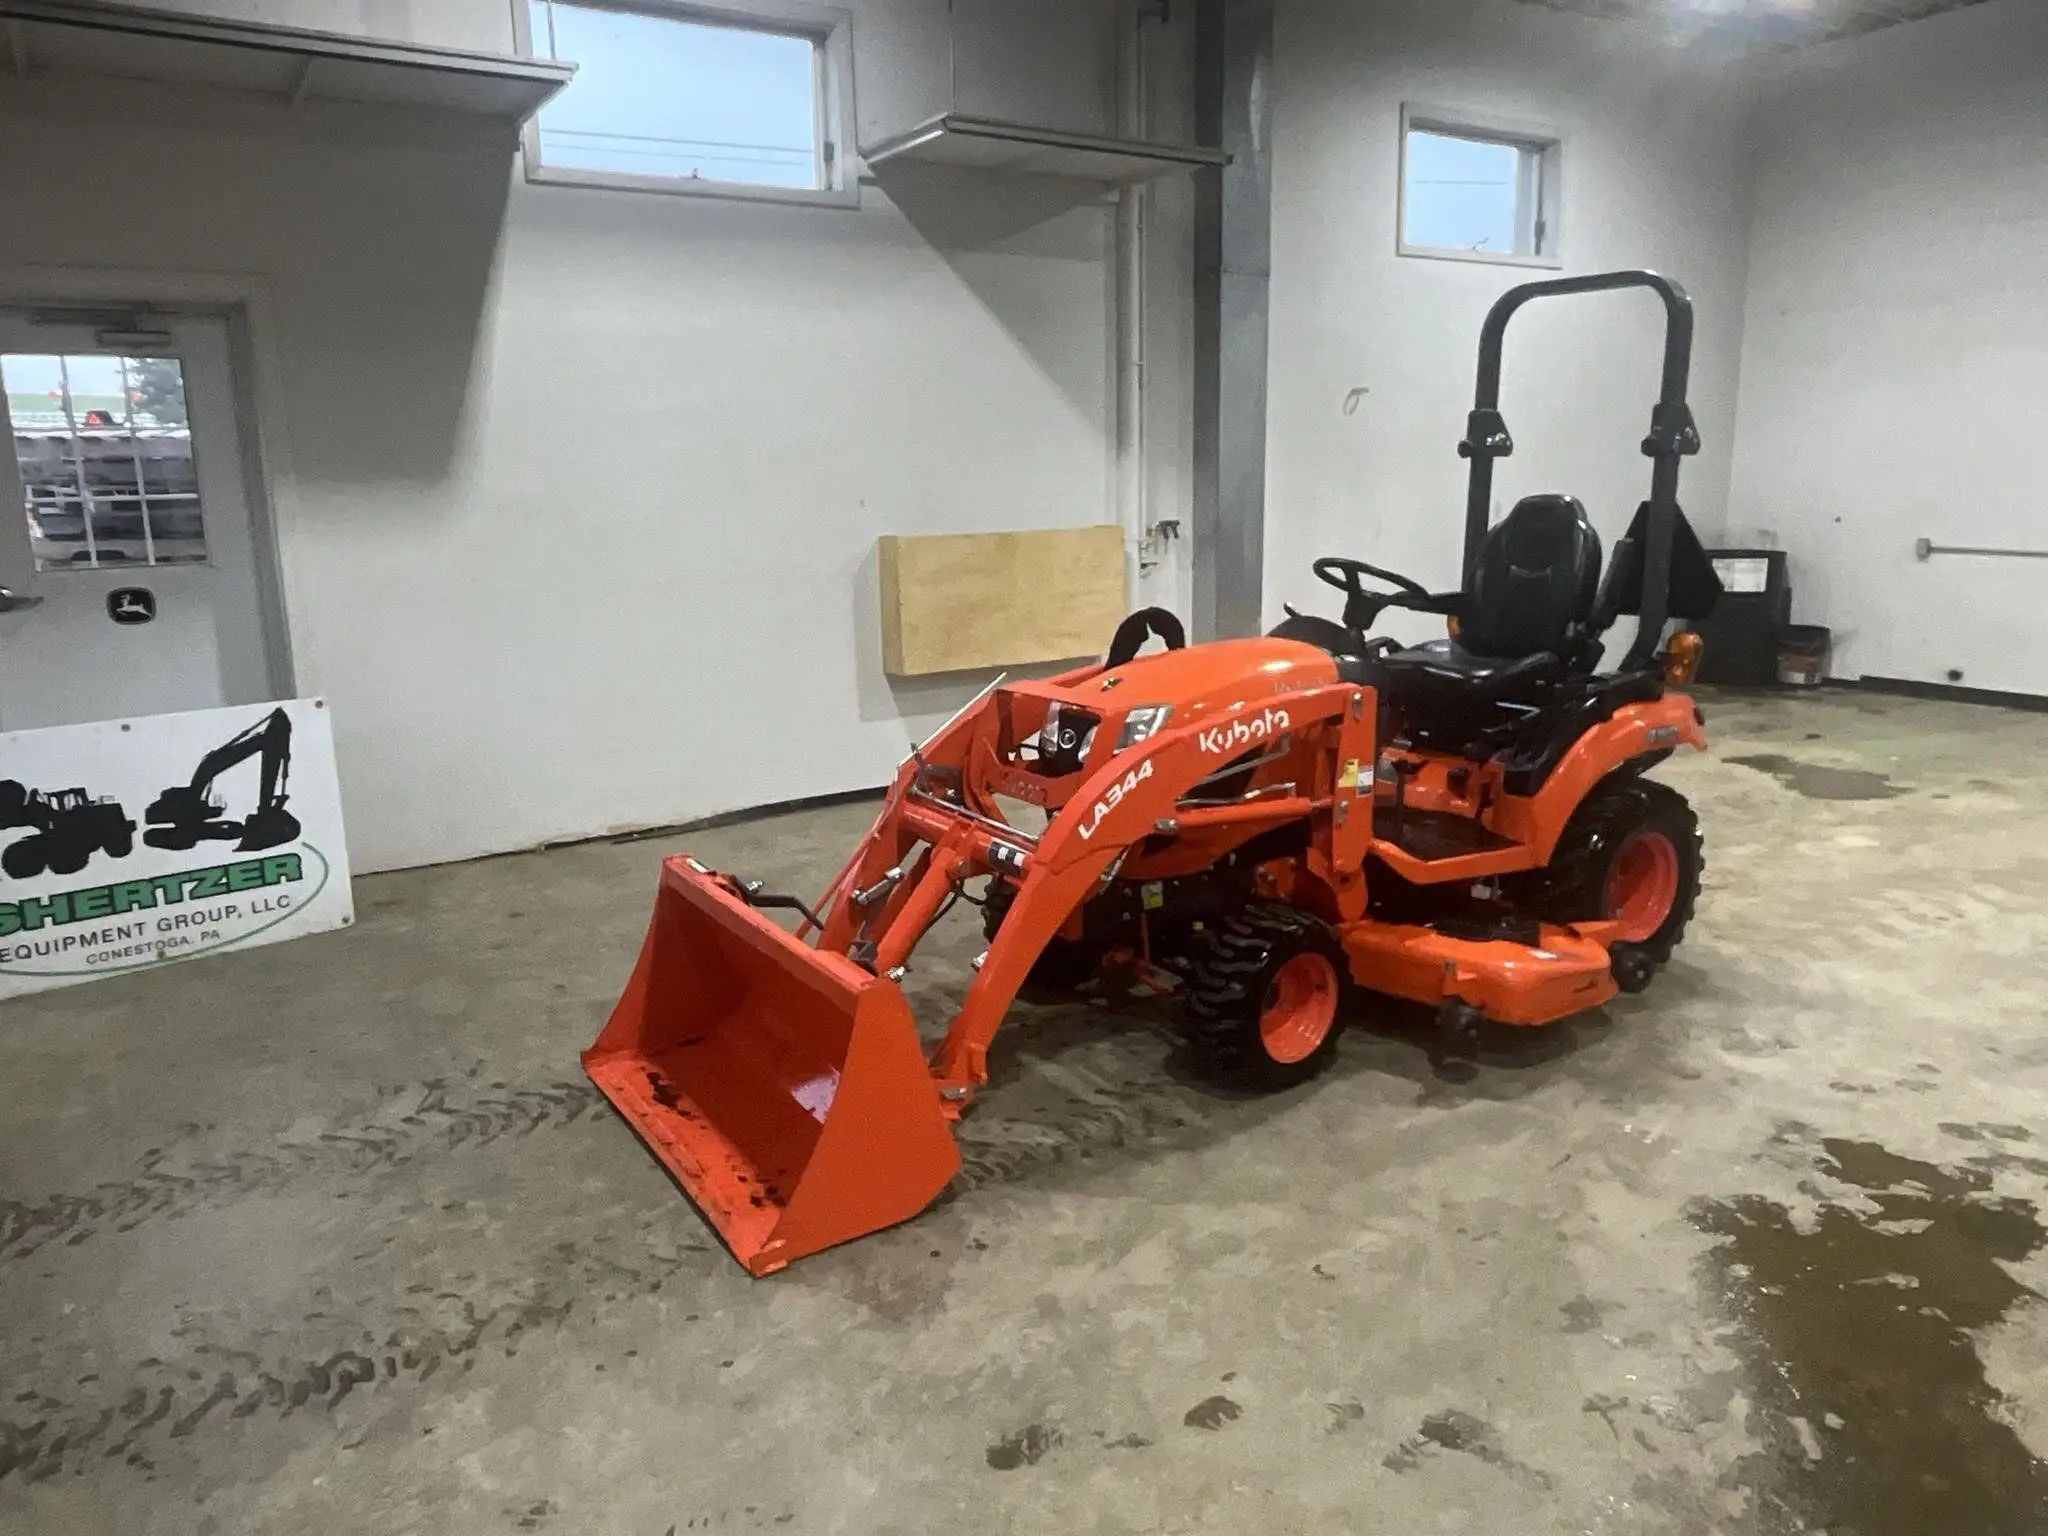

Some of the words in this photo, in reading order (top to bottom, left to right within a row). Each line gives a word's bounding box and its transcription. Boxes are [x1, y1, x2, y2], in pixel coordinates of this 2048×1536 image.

[1199, 708, 1290, 755] Kubota
[1078, 759, 1154, 840] LA344
[0, 922, 147, 964] EQUIPMENT
[251, 894, 292, 914] LLC
[200, 930, 221, 942] PA
